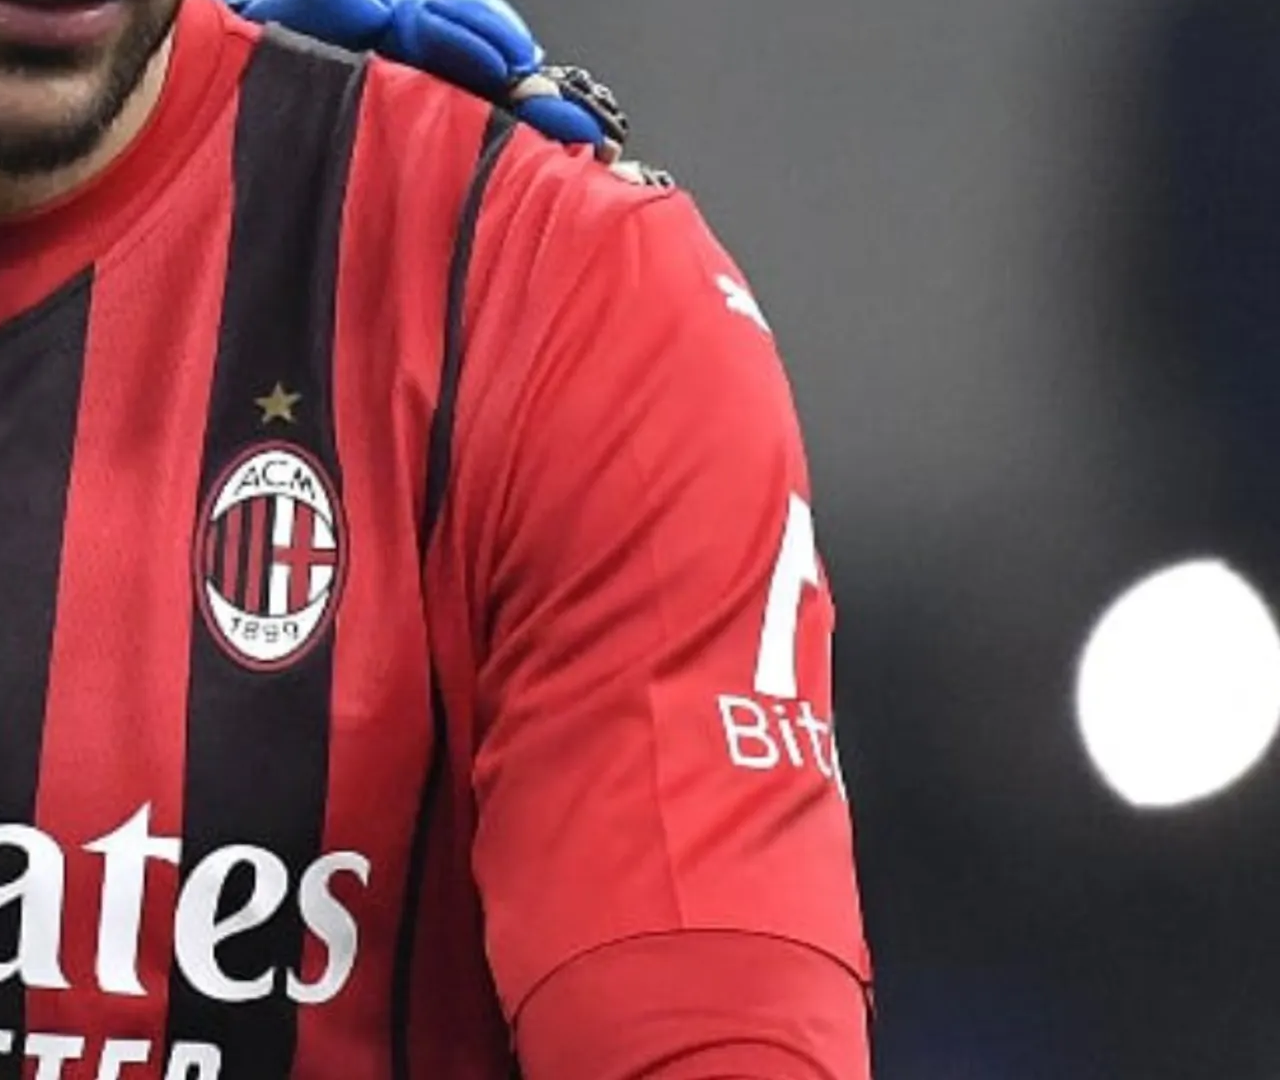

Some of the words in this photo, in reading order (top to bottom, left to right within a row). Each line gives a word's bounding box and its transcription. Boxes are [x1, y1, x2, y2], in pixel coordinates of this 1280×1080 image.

[233, 460, 316, 500] ACM
[230, 616, 300, 643] 1899
[717, 693, 847, 802] Bit
